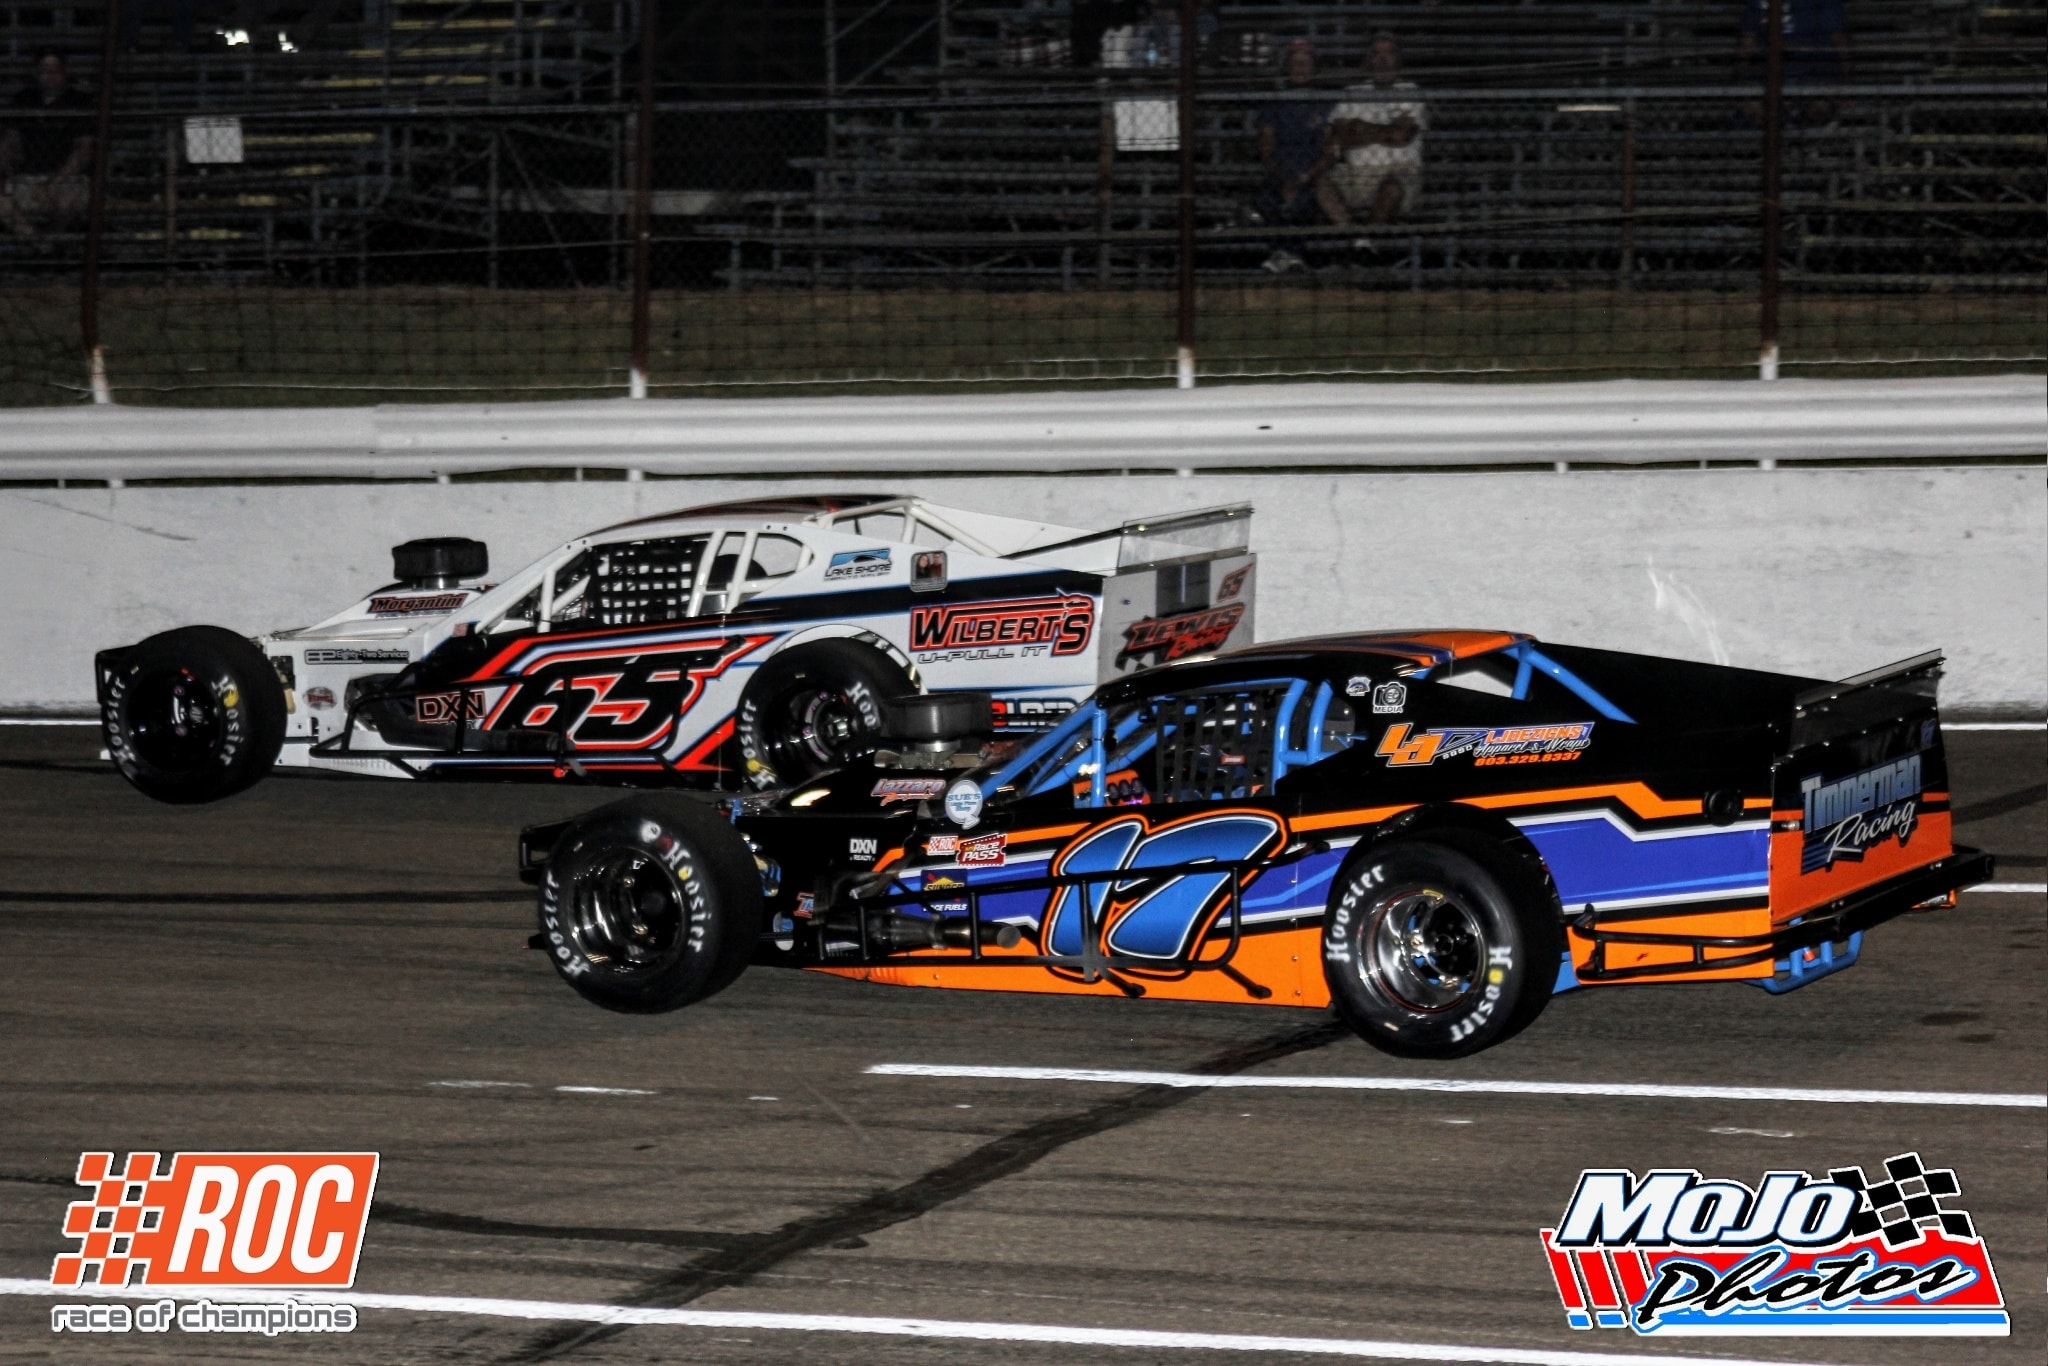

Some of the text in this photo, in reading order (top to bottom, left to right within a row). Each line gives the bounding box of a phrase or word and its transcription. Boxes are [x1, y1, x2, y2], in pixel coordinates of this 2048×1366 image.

[825, 566, 853, 578] LAKE
[855, 562, 891, 574] SHORE
[910, 592, 1094, 656] WILBERT'S
[917, 645, 1048, 664] U-PULL IT
[488, 640, 757, 748] 65
[418, 691, 485, 721] DXN
[1823, 800, 1916, 863] Racing
[850, 838, 877, 855] DXN
[938, 837, 955, 850] ROC
[973, 841, 1000, 850] Race
[962, 848, 999, 862] PASS
[1044, 812, 1282, 963] 17
[943, 903, 968, 912] FUELS
[1325, 864, 1385, 963] Hoosier
